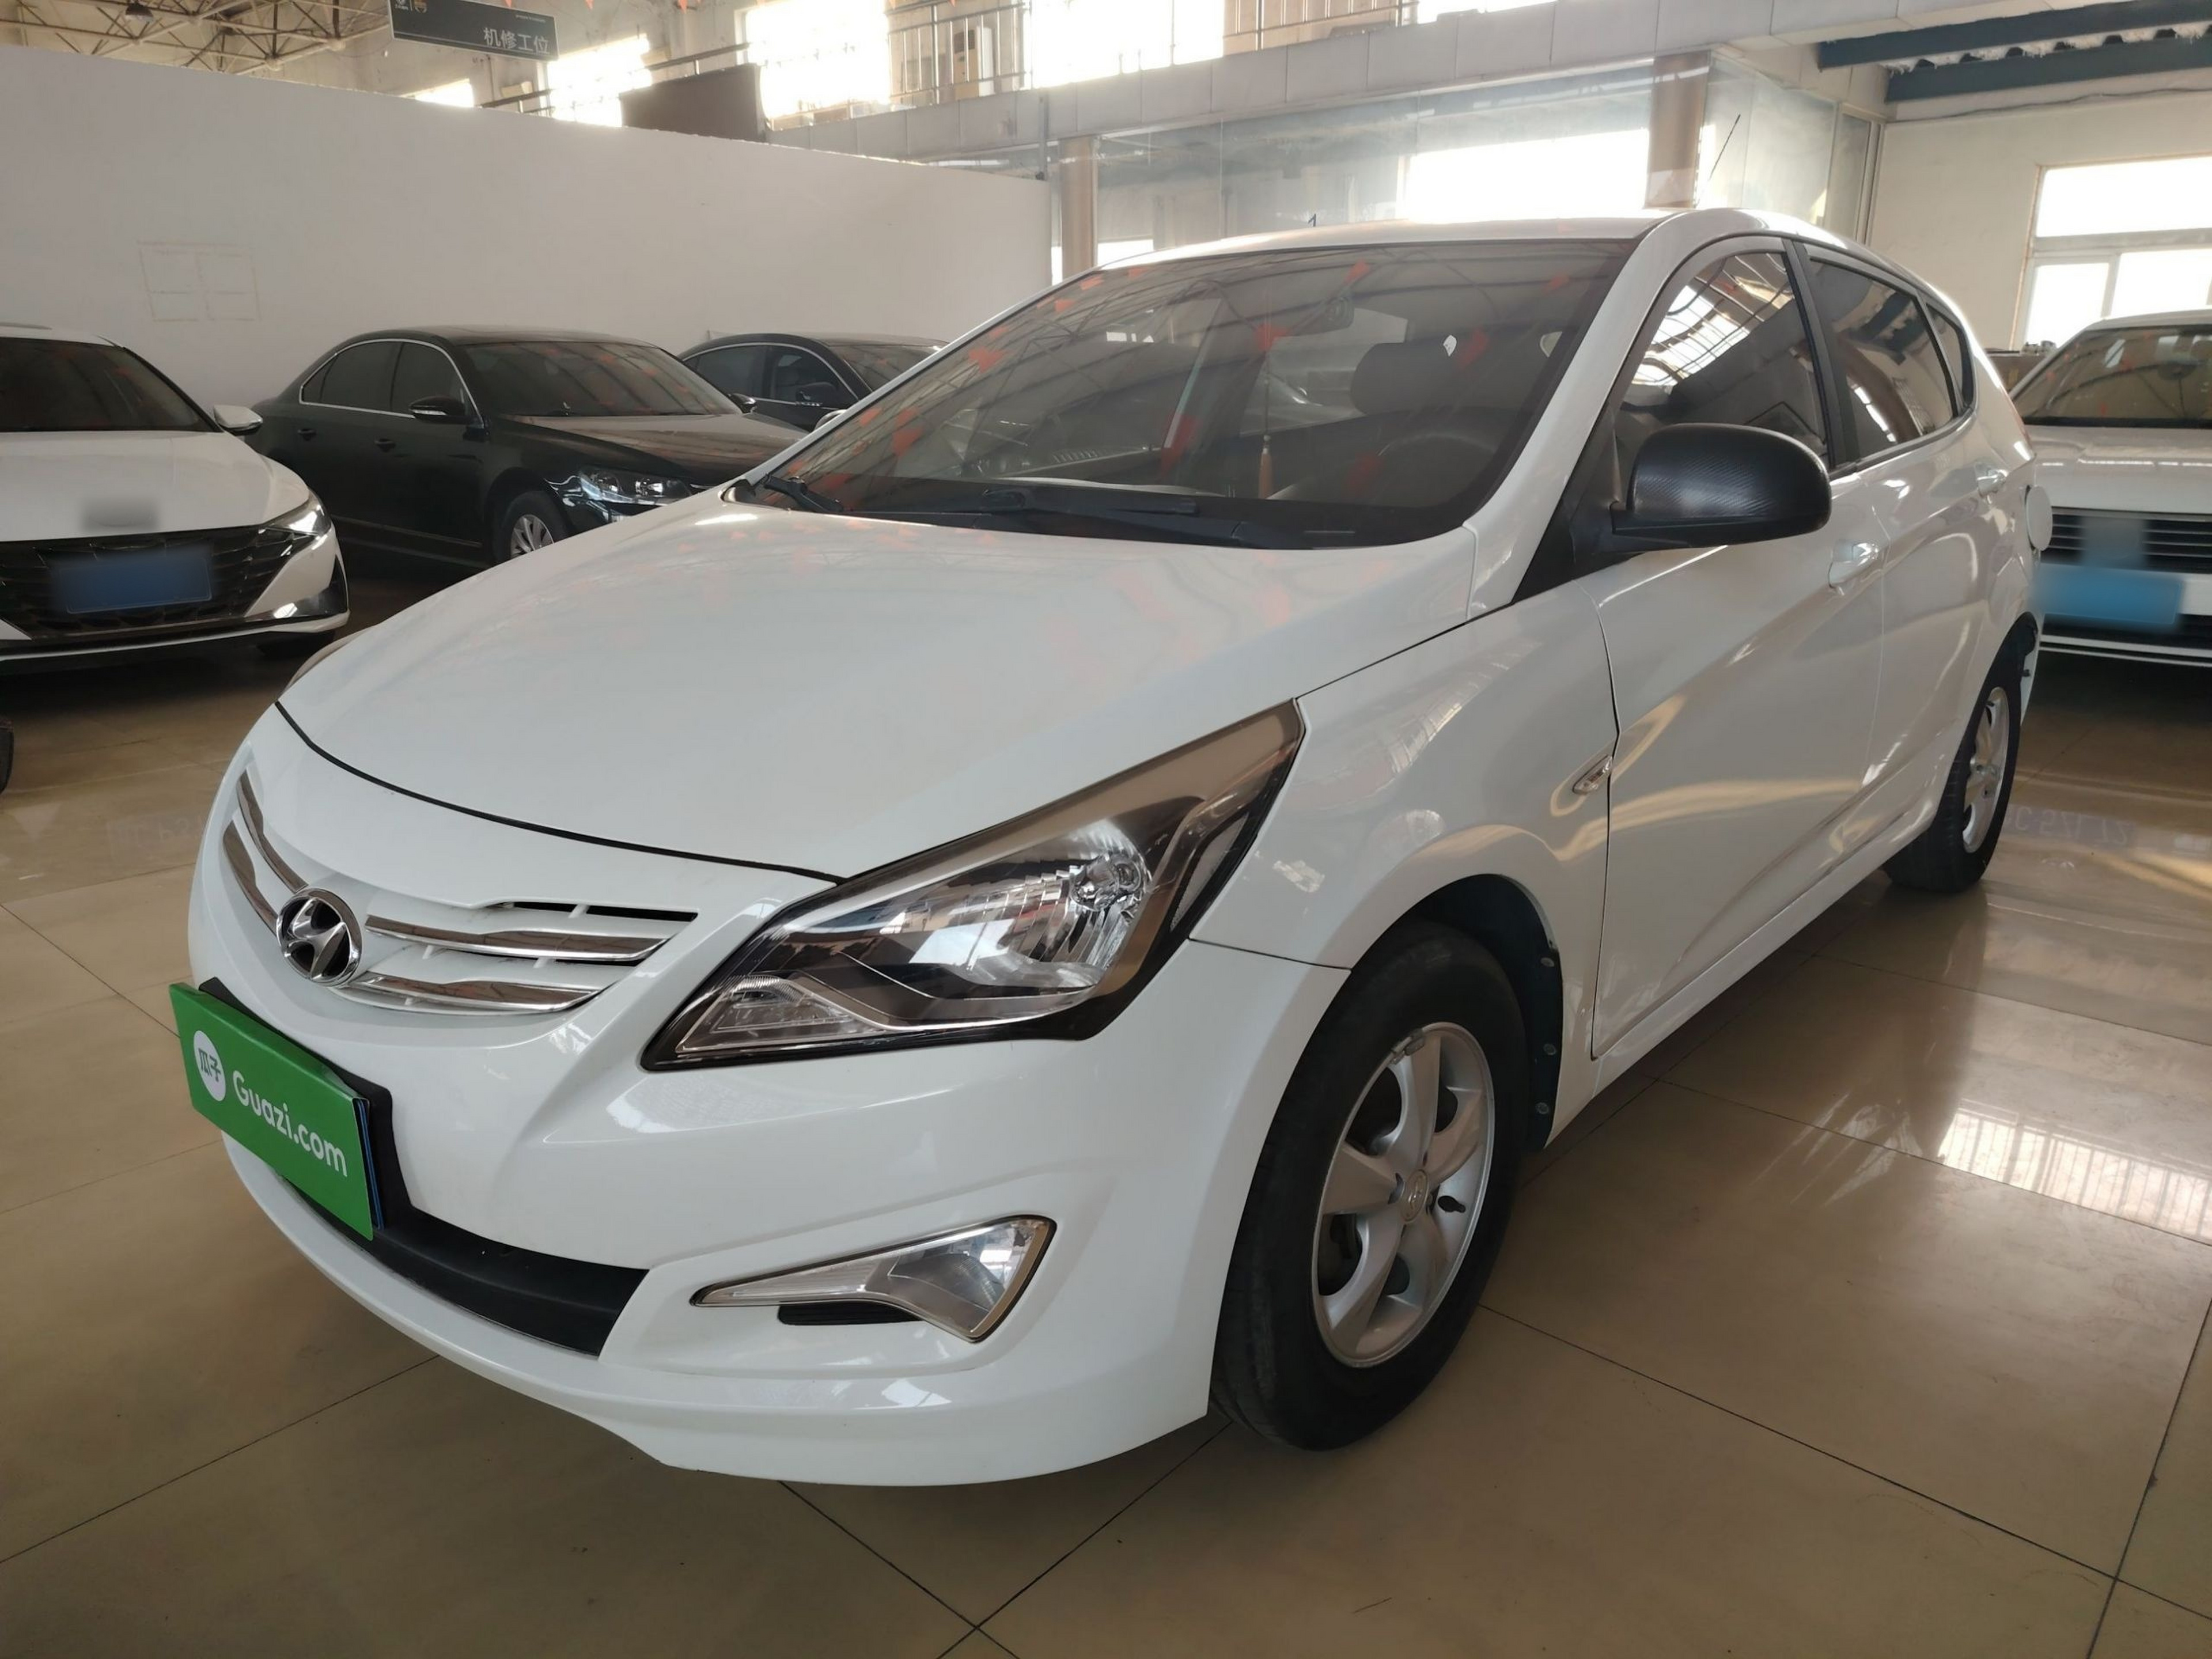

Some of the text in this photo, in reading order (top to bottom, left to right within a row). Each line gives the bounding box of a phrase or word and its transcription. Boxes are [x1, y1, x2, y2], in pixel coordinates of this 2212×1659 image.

[483, 27, 550, 55] 机修工位
[198, 1047, 221, 1082] 瓜子
[233, 1070, 347, 1177] Guazi.com
